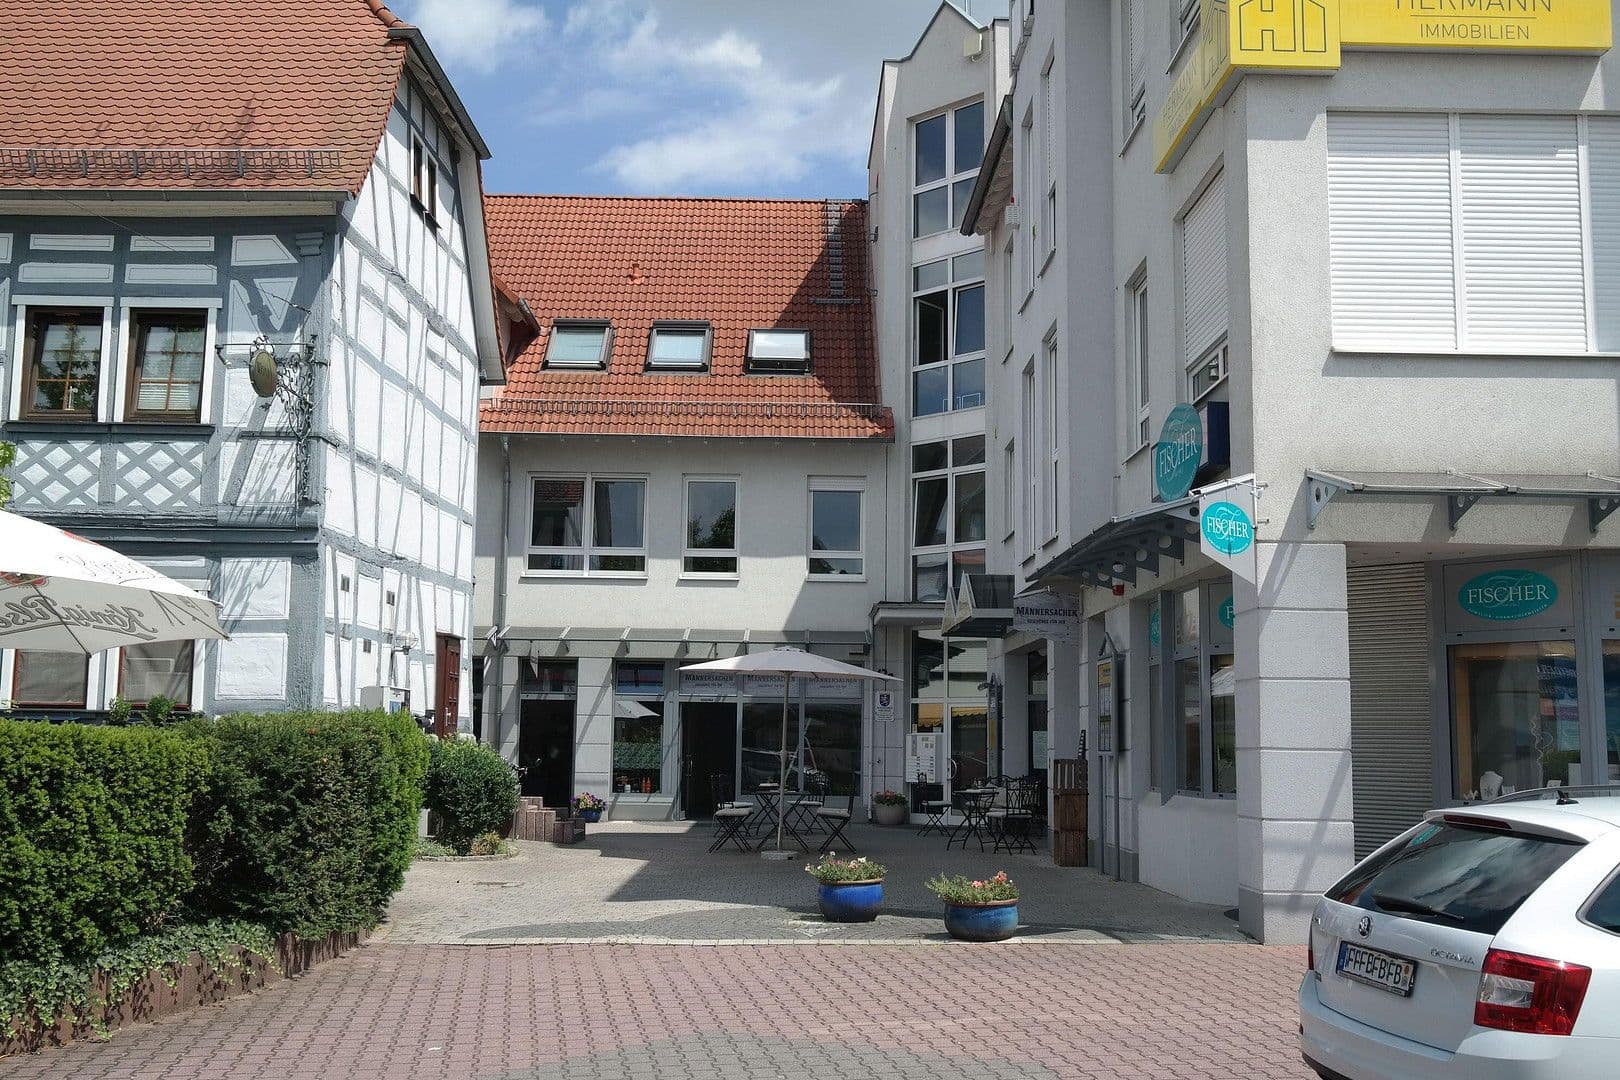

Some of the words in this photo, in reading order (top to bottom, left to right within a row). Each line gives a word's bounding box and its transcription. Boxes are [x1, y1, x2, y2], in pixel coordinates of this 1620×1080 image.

[1420, 23, 1530, 40] IMMOBILIEN
[1159, 427, 1198, 477] FISCHER
[1206, 515, 1250, 539] FISCHER
[1467, 584, 1550, 604] FISCHER
